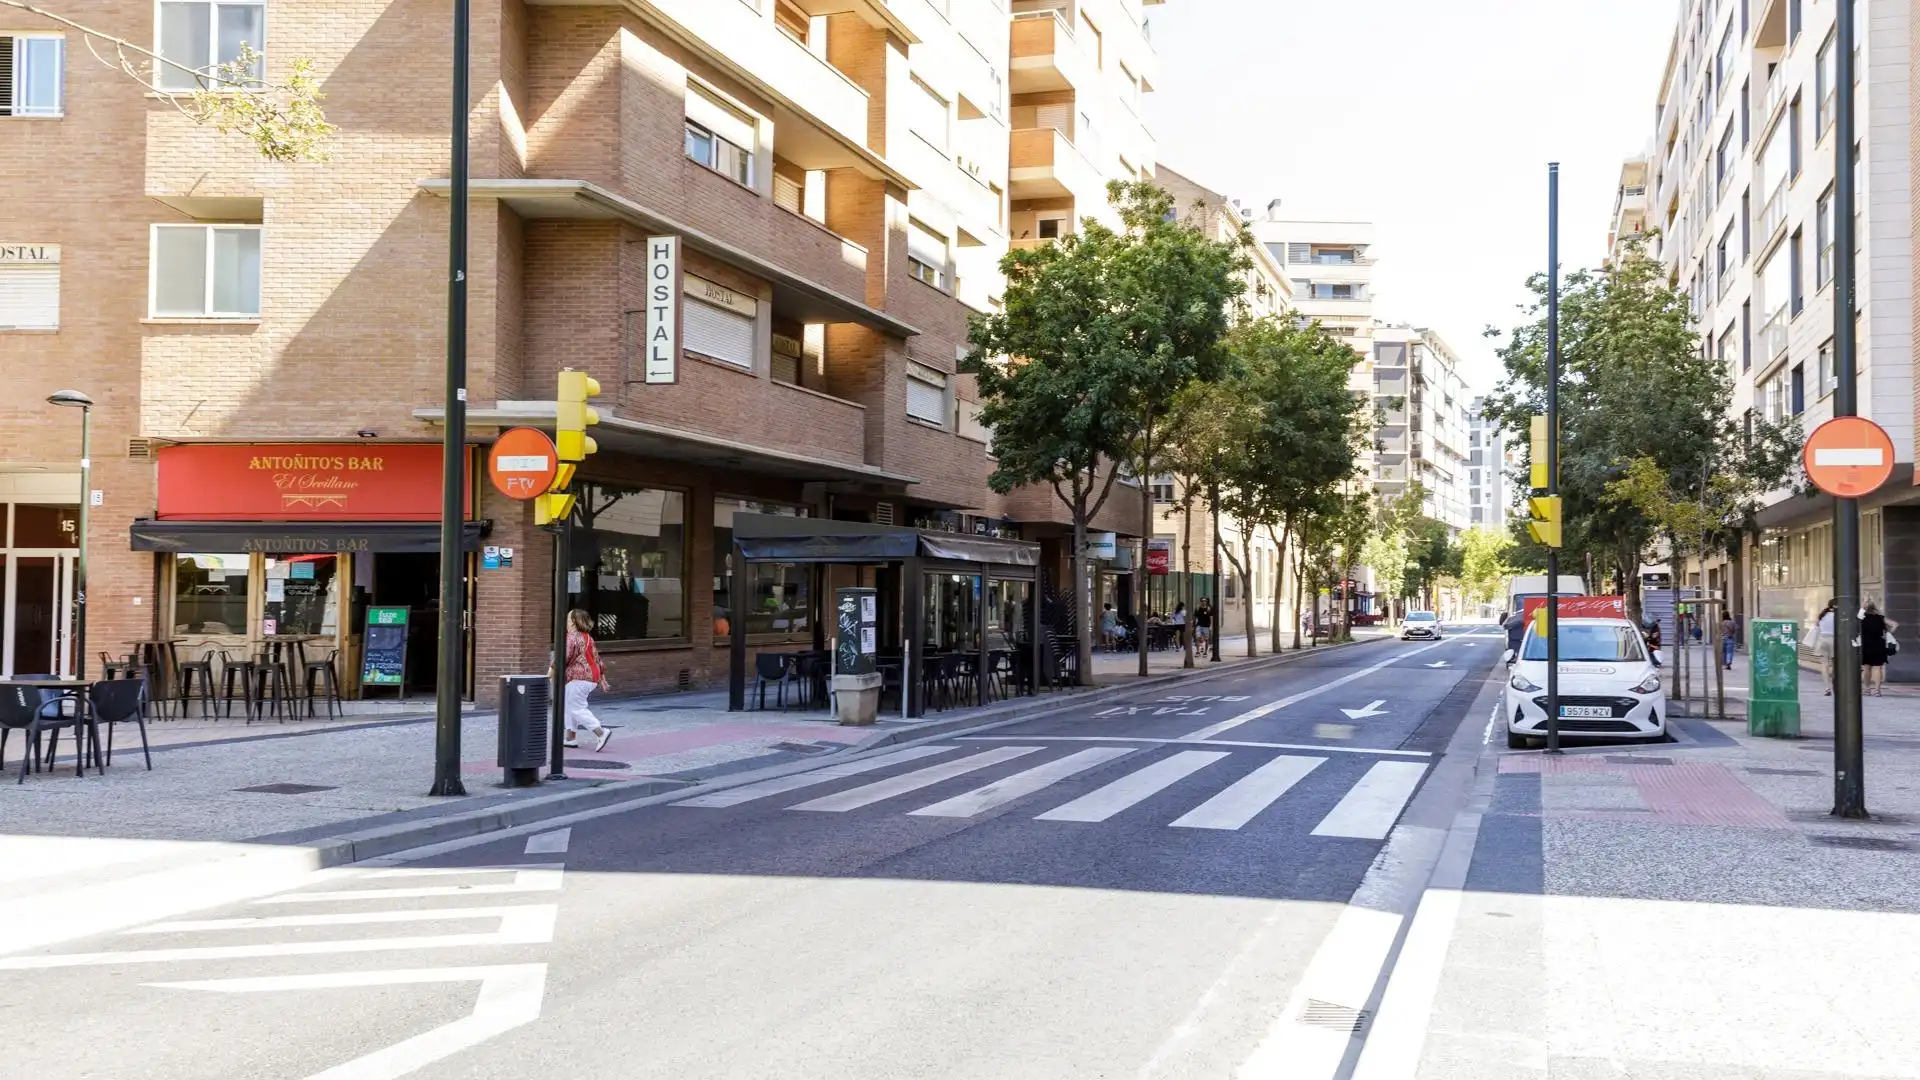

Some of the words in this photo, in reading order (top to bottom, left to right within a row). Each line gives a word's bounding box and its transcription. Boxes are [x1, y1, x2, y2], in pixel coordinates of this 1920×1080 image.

[652, 242, 670, 362] HOSTAL
[705, 282, 734, 306] HOSTAL
[249, 453, 345, 470] ANTOÑITO'S
[348, 456, 384, 471] BAR
[272, 473, 297, 489] El
[298, 473, 358, 489] Sevillano
[62, 519, 75, 532] 15
[241, 535, 329, 551] ANTOÑITO'S
[336, 538, 369, 551] BAR
[1091, 706, 1212, 719] TAXI
